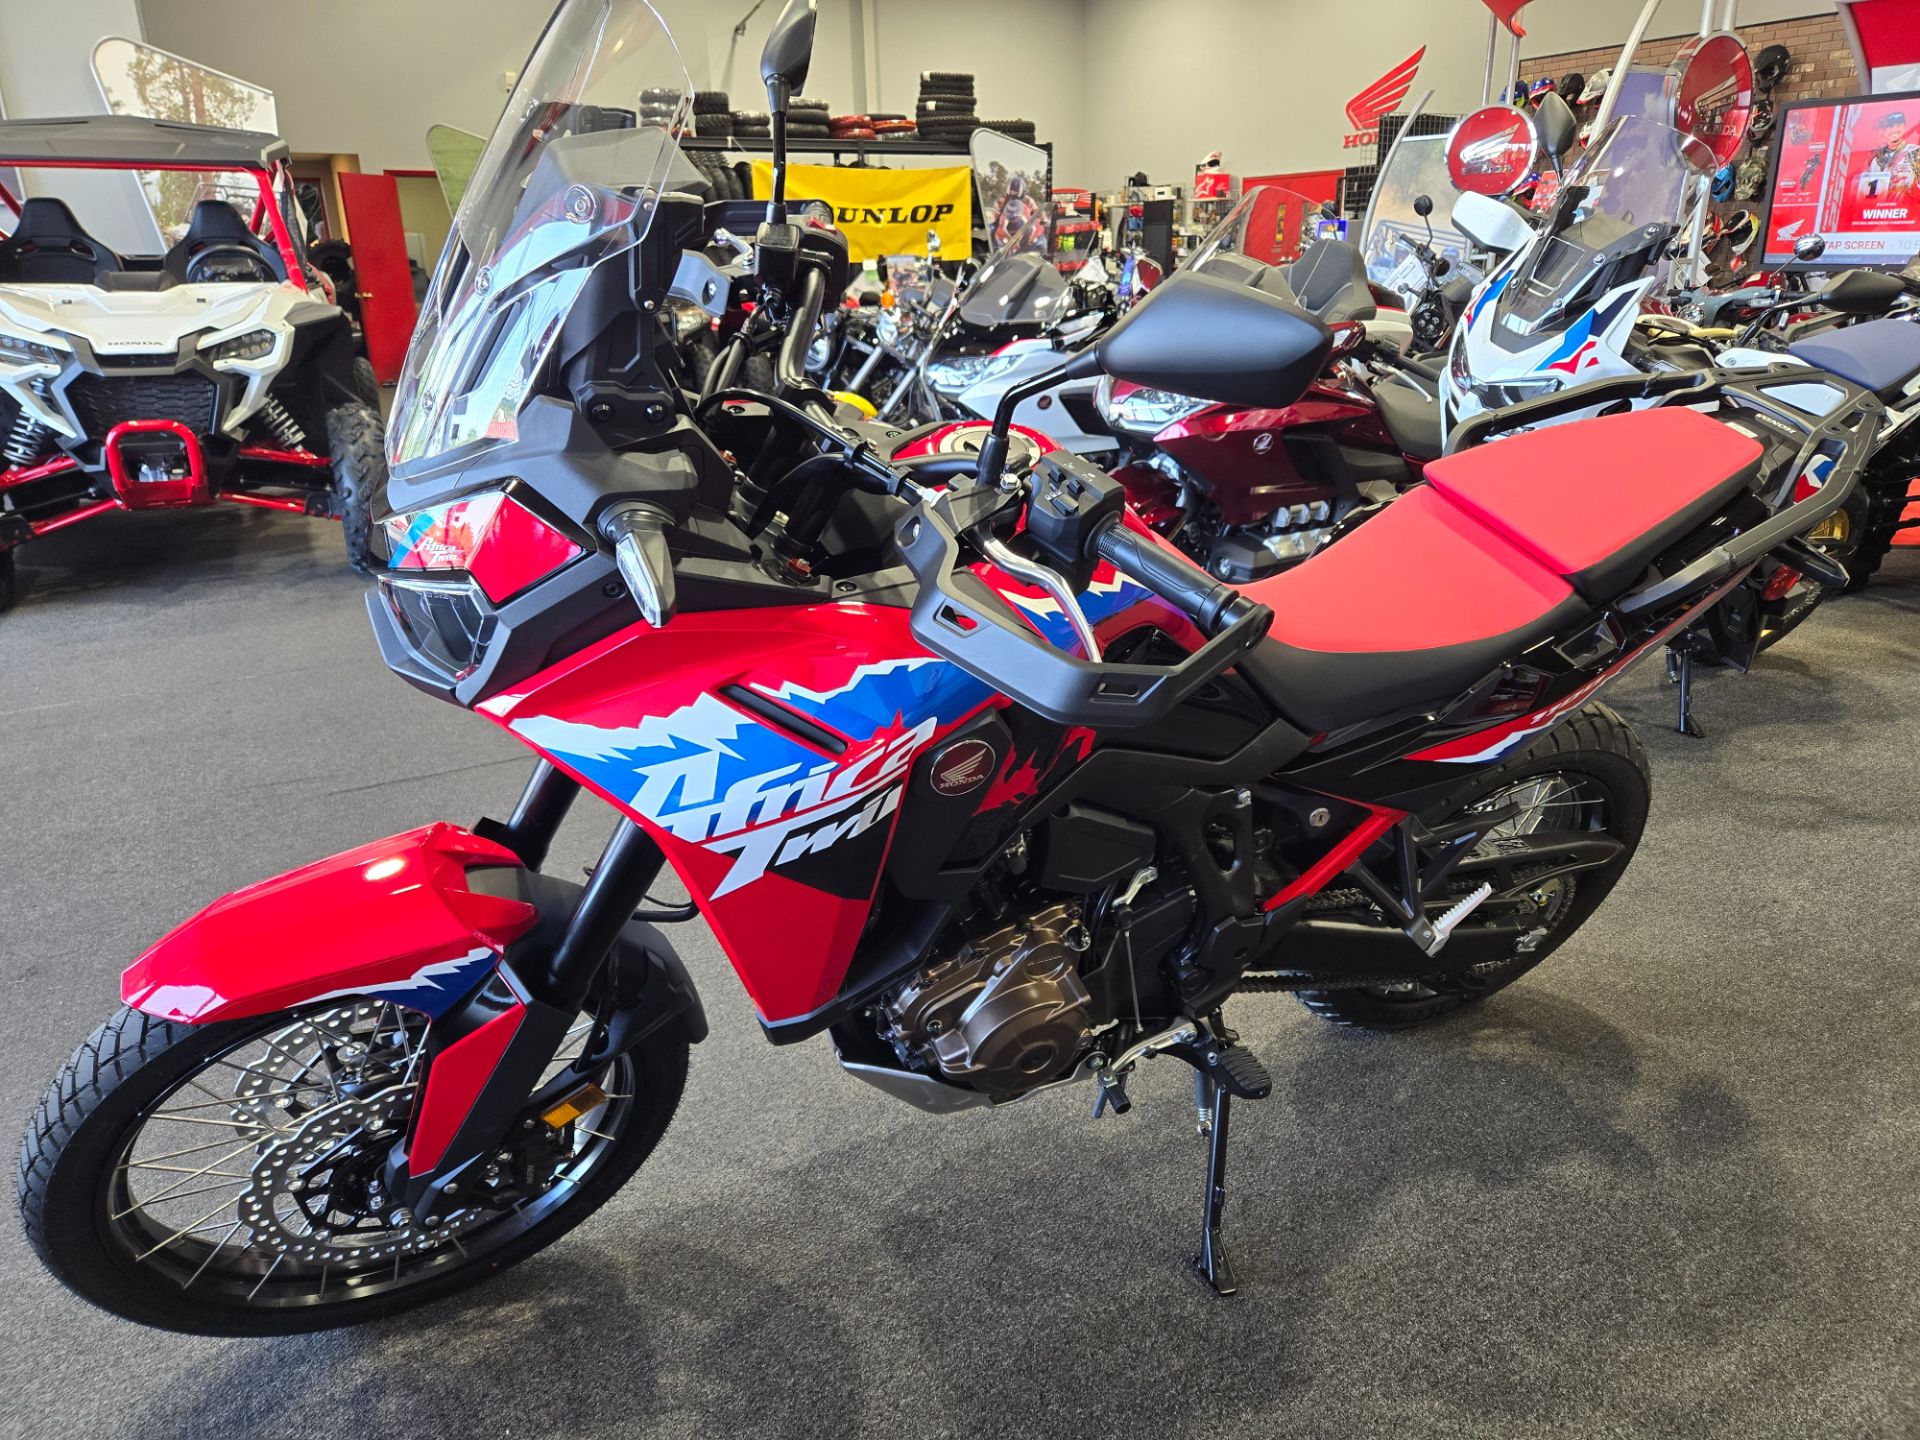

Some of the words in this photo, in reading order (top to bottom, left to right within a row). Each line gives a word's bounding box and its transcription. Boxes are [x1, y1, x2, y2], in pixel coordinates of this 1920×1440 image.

[1865, 178, 1878, 199] 1
[837, 204, 954, 224] UNLOP
[1863, 208, 1908, 219] WINNER
[1844, 240, 1886, 250] SCREEN
[1755, 413, 1797, 434] HONDA
[415, 536, 457, 554] Africa
[428, 549, 465, 567] Twin
[629, 716, 938, 844] Africa
[939, 774, 984, 789] HONDA
